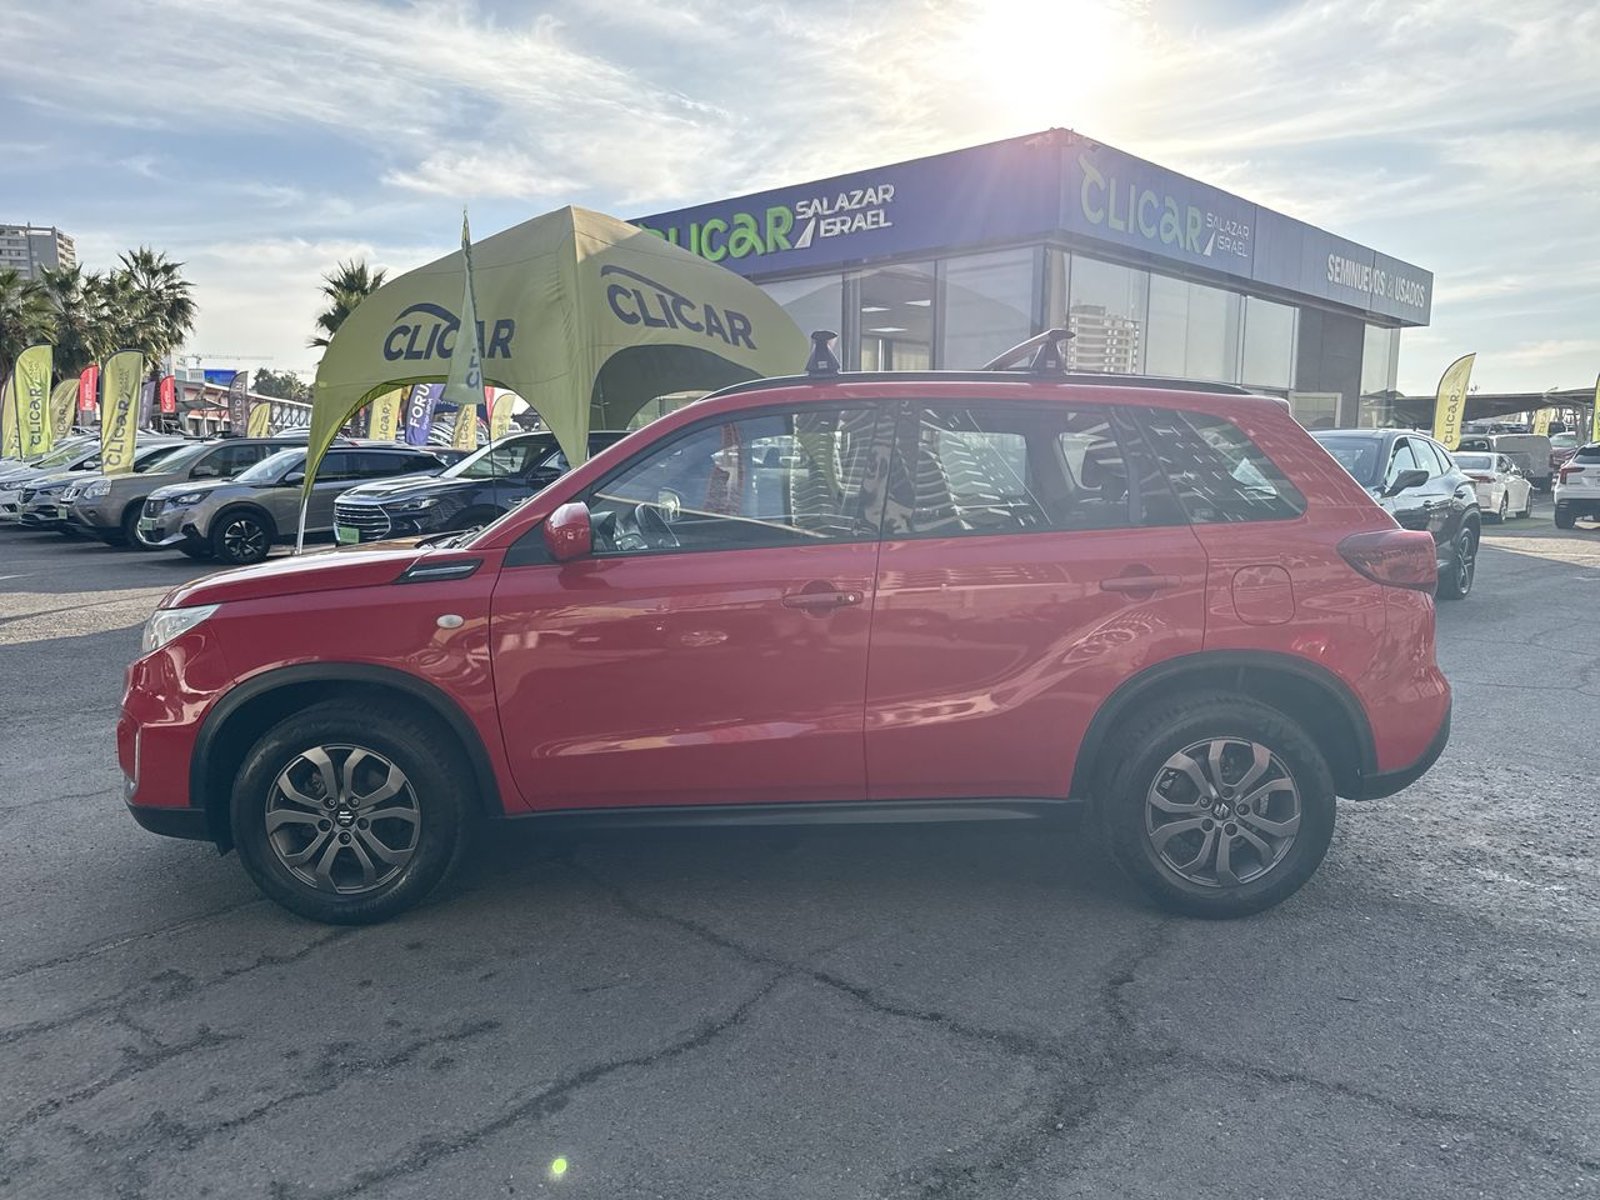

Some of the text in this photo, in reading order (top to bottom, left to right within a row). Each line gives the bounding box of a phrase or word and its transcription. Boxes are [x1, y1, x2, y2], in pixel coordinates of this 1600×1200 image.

[795, 184, 895, 219] SALAZAR
[640, 206, 794, 261] ICaR
[819, 209, 893, 238] ISRAEL
[1206, 212, 1249, 241] SALAZAR
[1216, 238, 1249, 258] ISRAEL
[1327, 253, 1386, 296] SEMINUEVOS
[1394, 276, 1425, 308] USADOS
[606, 283, 758, 350] CLICAR
[410, 382, 432, 429] FORU
